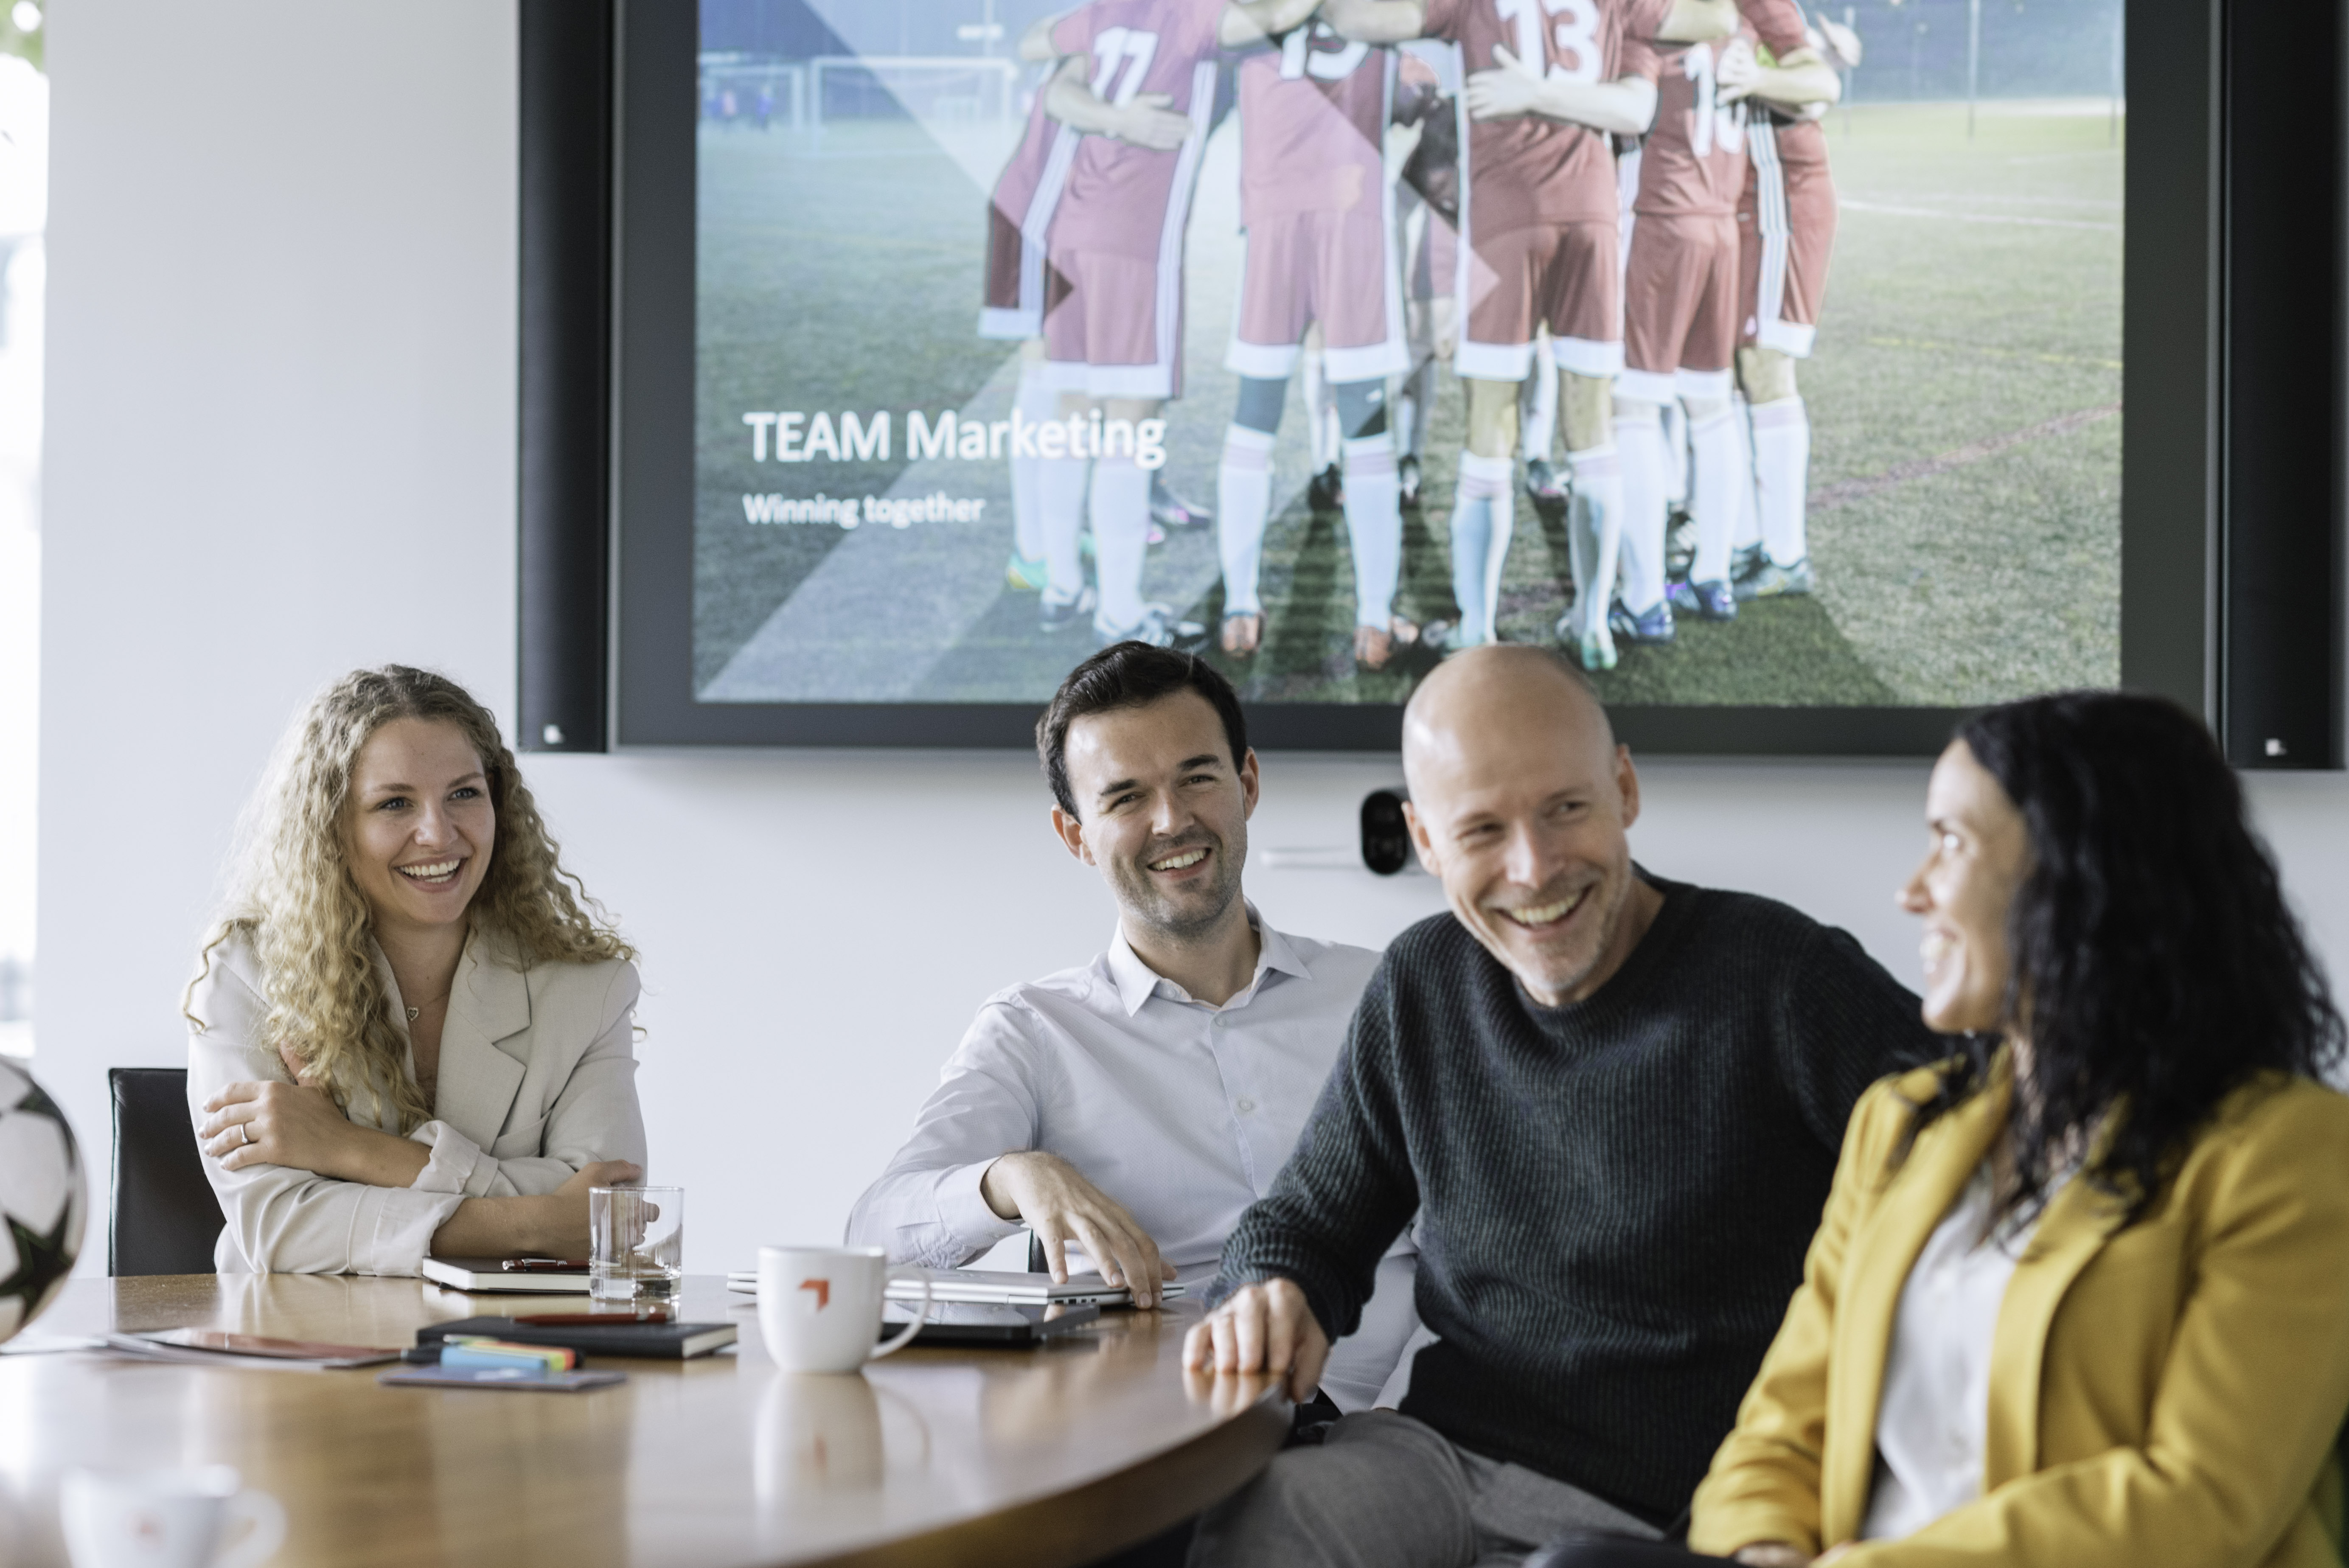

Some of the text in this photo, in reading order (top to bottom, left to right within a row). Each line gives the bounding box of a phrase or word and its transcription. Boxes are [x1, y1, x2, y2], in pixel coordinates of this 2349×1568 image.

[742, 407, 1167, 470] TEAM Marketing
[742, 491, 986, 530] Winning together
